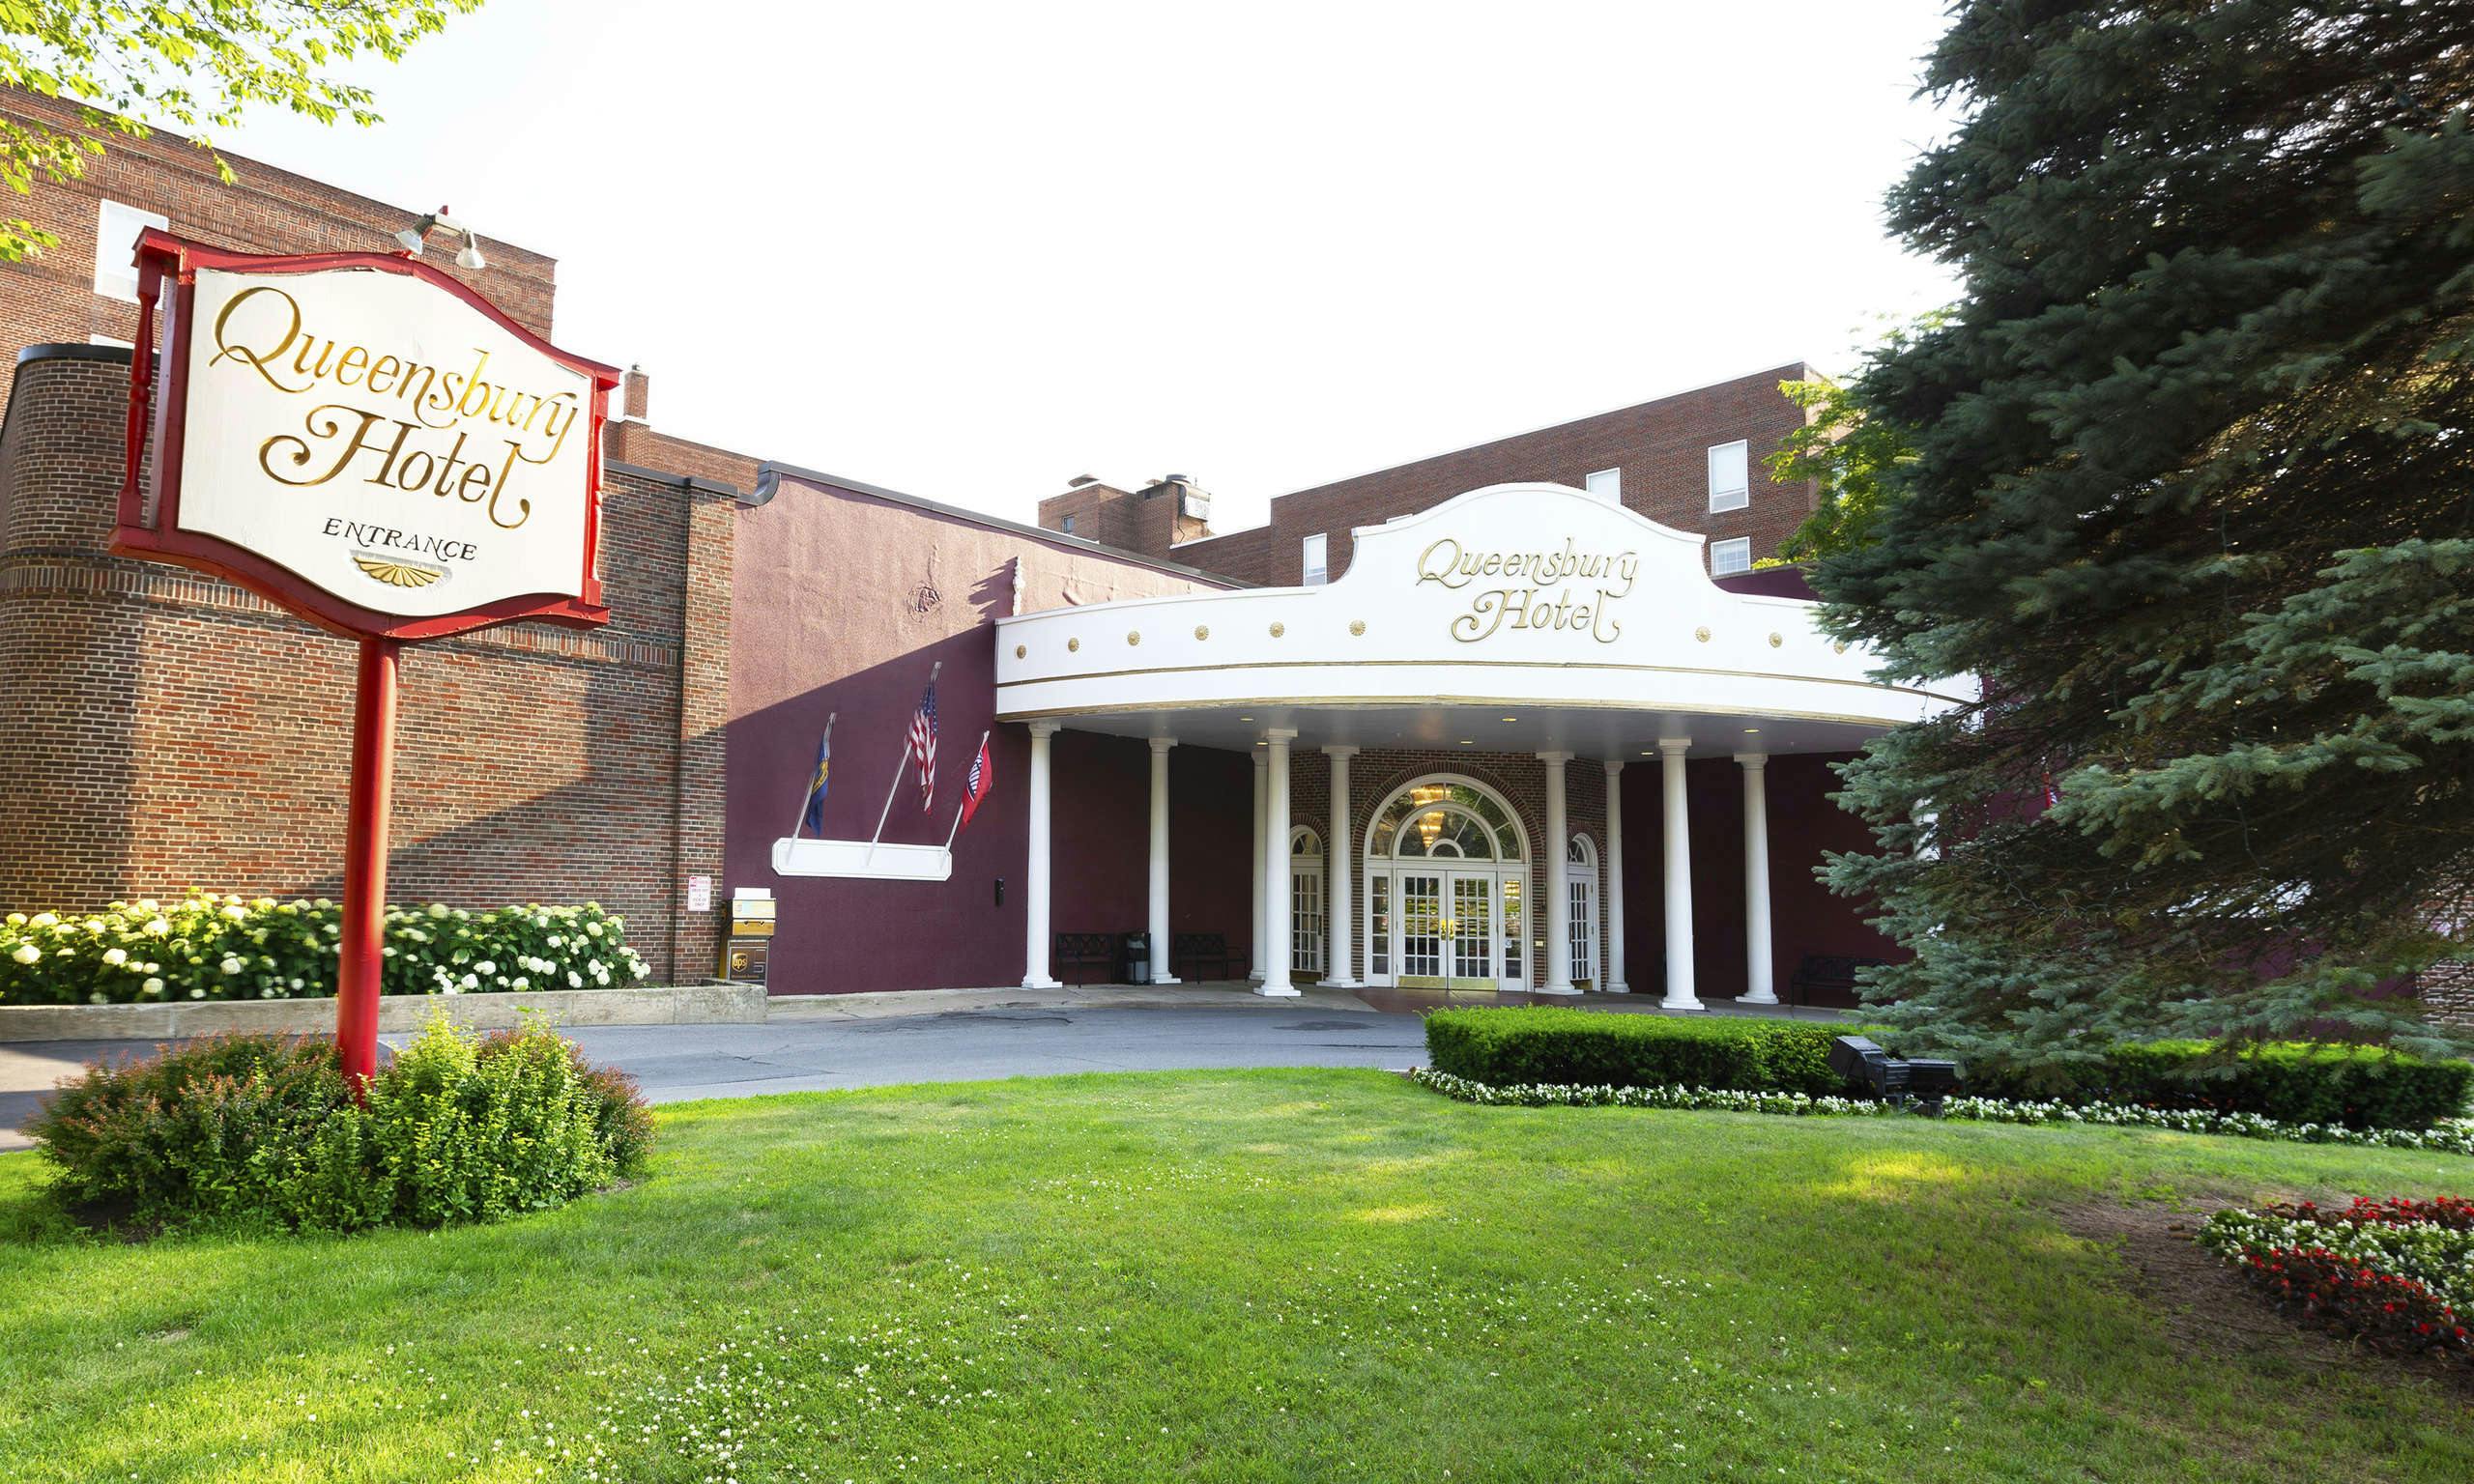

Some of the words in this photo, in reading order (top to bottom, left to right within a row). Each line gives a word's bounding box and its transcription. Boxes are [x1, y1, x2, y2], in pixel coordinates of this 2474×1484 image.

[209, 286, 578, 464] Queensbury
[258, 404, 531, 529] Hotel
[322, 517, 477, 562] ENTRANCE
[1415, 537, 1639, 598] Queensbury
[1451, 588, 1621, 643] Hotel
